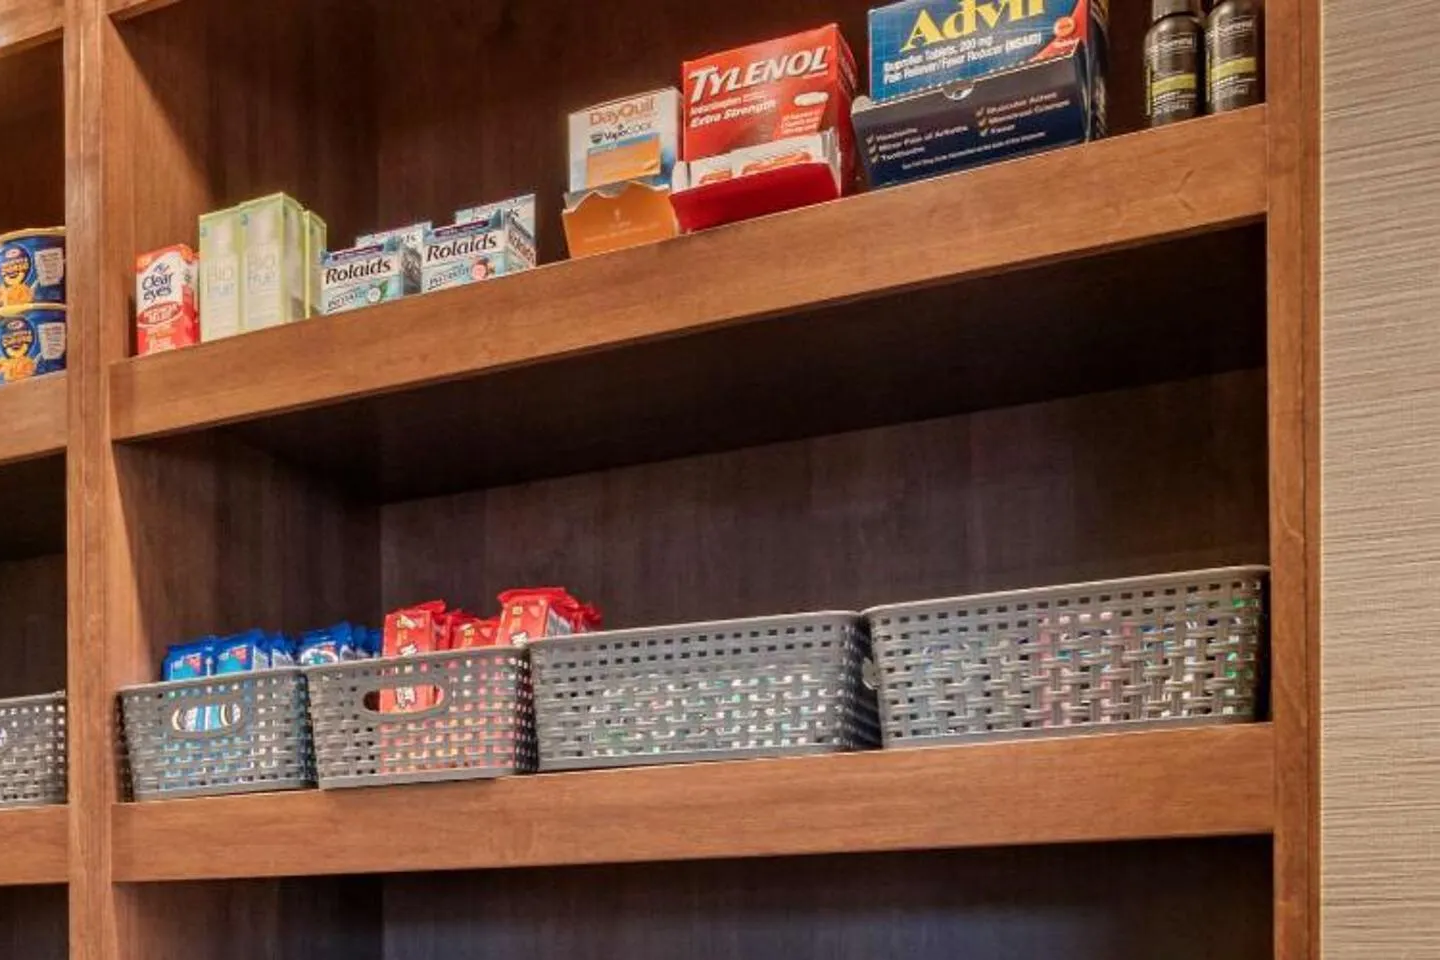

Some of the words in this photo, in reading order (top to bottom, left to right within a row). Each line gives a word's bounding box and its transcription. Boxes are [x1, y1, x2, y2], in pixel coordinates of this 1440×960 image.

[899, 0, 1046, 52] Advil
[689, 46, 829, 104] TYLENOL
[427, 233, 497, 262] Rolaids
[142, 271, 173, 291] Clear
[325, 257, 391, 285] Rolaids
